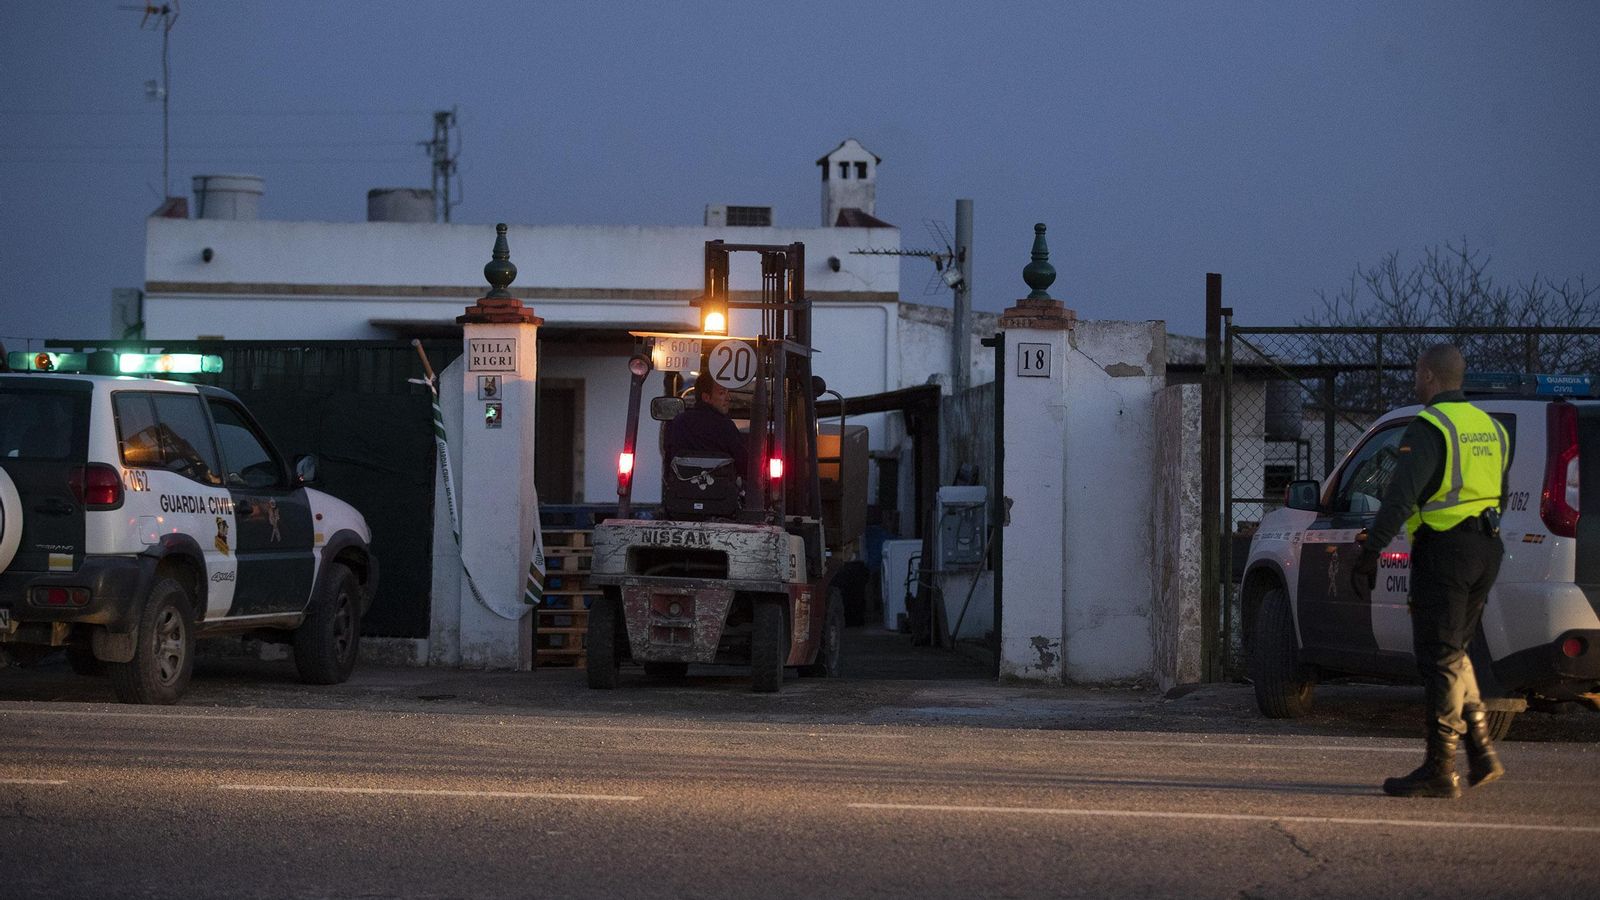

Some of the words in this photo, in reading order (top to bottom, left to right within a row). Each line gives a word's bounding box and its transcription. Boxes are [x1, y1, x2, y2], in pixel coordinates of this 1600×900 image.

[472, 343, 511, 353] VILLA
[671, 341, 699, 353] 6010
[473, 356, 512, 366] RIGRI
[716, 346, 751, 382] 20
[1023, 349, 1044, 370] 18
[1546, 376, 1581, 384] GUARDIA
[1553, 385, 1574, 393] CIVIL
[1459, 432, 1498, 443] GUARDIA
[1471, 446, 1493, 457] CIVIL
[129, 471, 151, 492] 062
[160, 494, 206, 515] GUARDIA
[209, 496, 233, 515] CIVIL
[1511, 491, 1530, 511] 062
[641, 531, 711, 546] NISSAN
[1386, 575, 1408, 592] CIVIL
